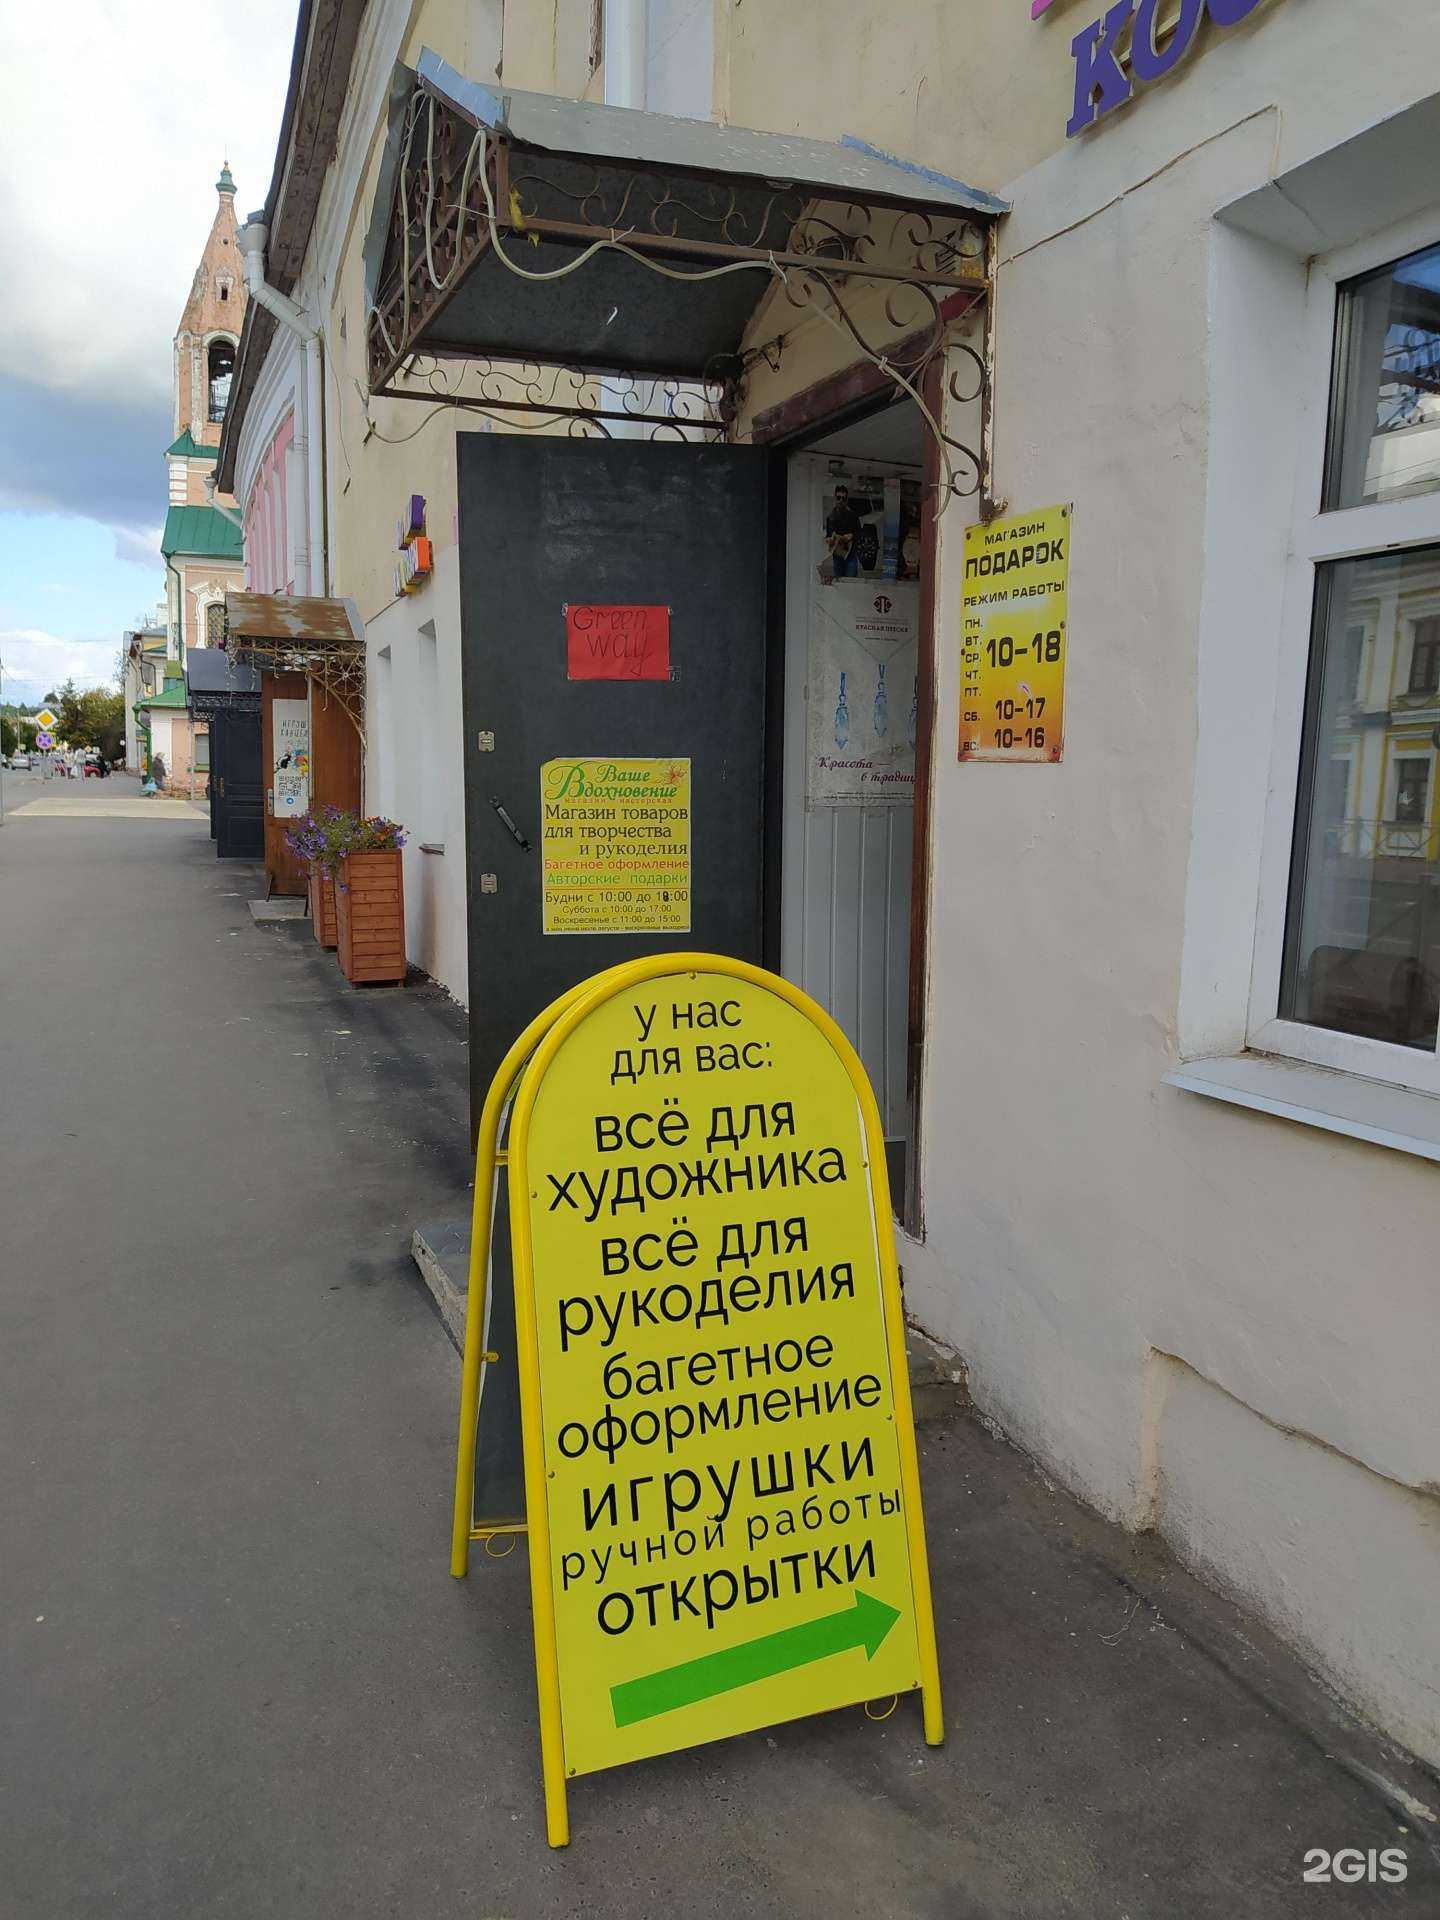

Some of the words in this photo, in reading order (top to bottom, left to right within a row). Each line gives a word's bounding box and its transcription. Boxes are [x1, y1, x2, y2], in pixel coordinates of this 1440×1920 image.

[1066, 0, 1262, 139] КО
[984, 521, 1046, 546] МАГАЗИН
[964, 537, 1066, 579] ПОДАРОК
[963, 589, 1009, 608] РЕЖИМ
[1011, 580, 1066, 600] РАБОТЫ
[573, 606, 648, 631] Green
[964, 617, 983, 630] ПН.
[964, 634, 983, 647] ВТ.
[985, 630, 1062, 668] 10-18
[964, 652, 982, 664] СР.
[964, 669, 982, 681] ЧТ.
[963, 686, 982, 698] ПТ.
[994, 697, 1046, 720] 10-17
[994, 726, 1045, 749] 10-16
[596, 764, 651, 783] Ваше
[817, 755, 873, 771] Красота
[544, 761, 678, 800] Вдохновение
[544, 804, 616, 820] Магазин
[620, 808, 689, 823] товаров
[544, 826, 574, 839] для
[579, 826, 673, 841] творчества
[579, 843, 590, 856] и
[595, 842, 689, 858] рукоделия
[544, 859, 604, 870] Багетное
[607, 859, 690, 872] оформление
[546, 873, 622, 885] Авторские
[629, 874, 689, 886] подарки
[545, 891, 583, 904] Будни
[587, 893, 594, 902] с
[599, 891, 633, 902] 10:00
[635, 893, 651, 904] до
[562, 906, 600, 914] Суббота
[609, 905, 633, 913] 10:00
[635, 906, 646, 914] до
[648, 905, 672, 913] 17:00
[553, 915, 610, 925] Воскресенье
[620, 915, 642, 923] 11:00
[644, 916, 655, 924] до
[658, 915, 681, 923] 15:00
[633, 1001, 658, 1042] у
[671, 998, 743, 1030] нас
[610, 1046, 682, 1085] для
[695, 1041, 774, 1074] вас:
[594, 1097, 690, 1153] всё
[705, 1101, 797, 1154] для
[546, 1146, 847, 1223] художника
[600, 1215, 699, 1277] всё
[716, 1216, 810, 1273] для
[558, 1262, 856, 1353] рукоделия
[602, 1334, 834, 1401] багетное
[557, 1373, 882, 1464] оформление
[582, 1436, 876, 1532] игрушки
[561, 1513, 726, 1591] ручной
[746, 1488, 903, 1552] работы
[596, 1539, 878, 1636] открытки
